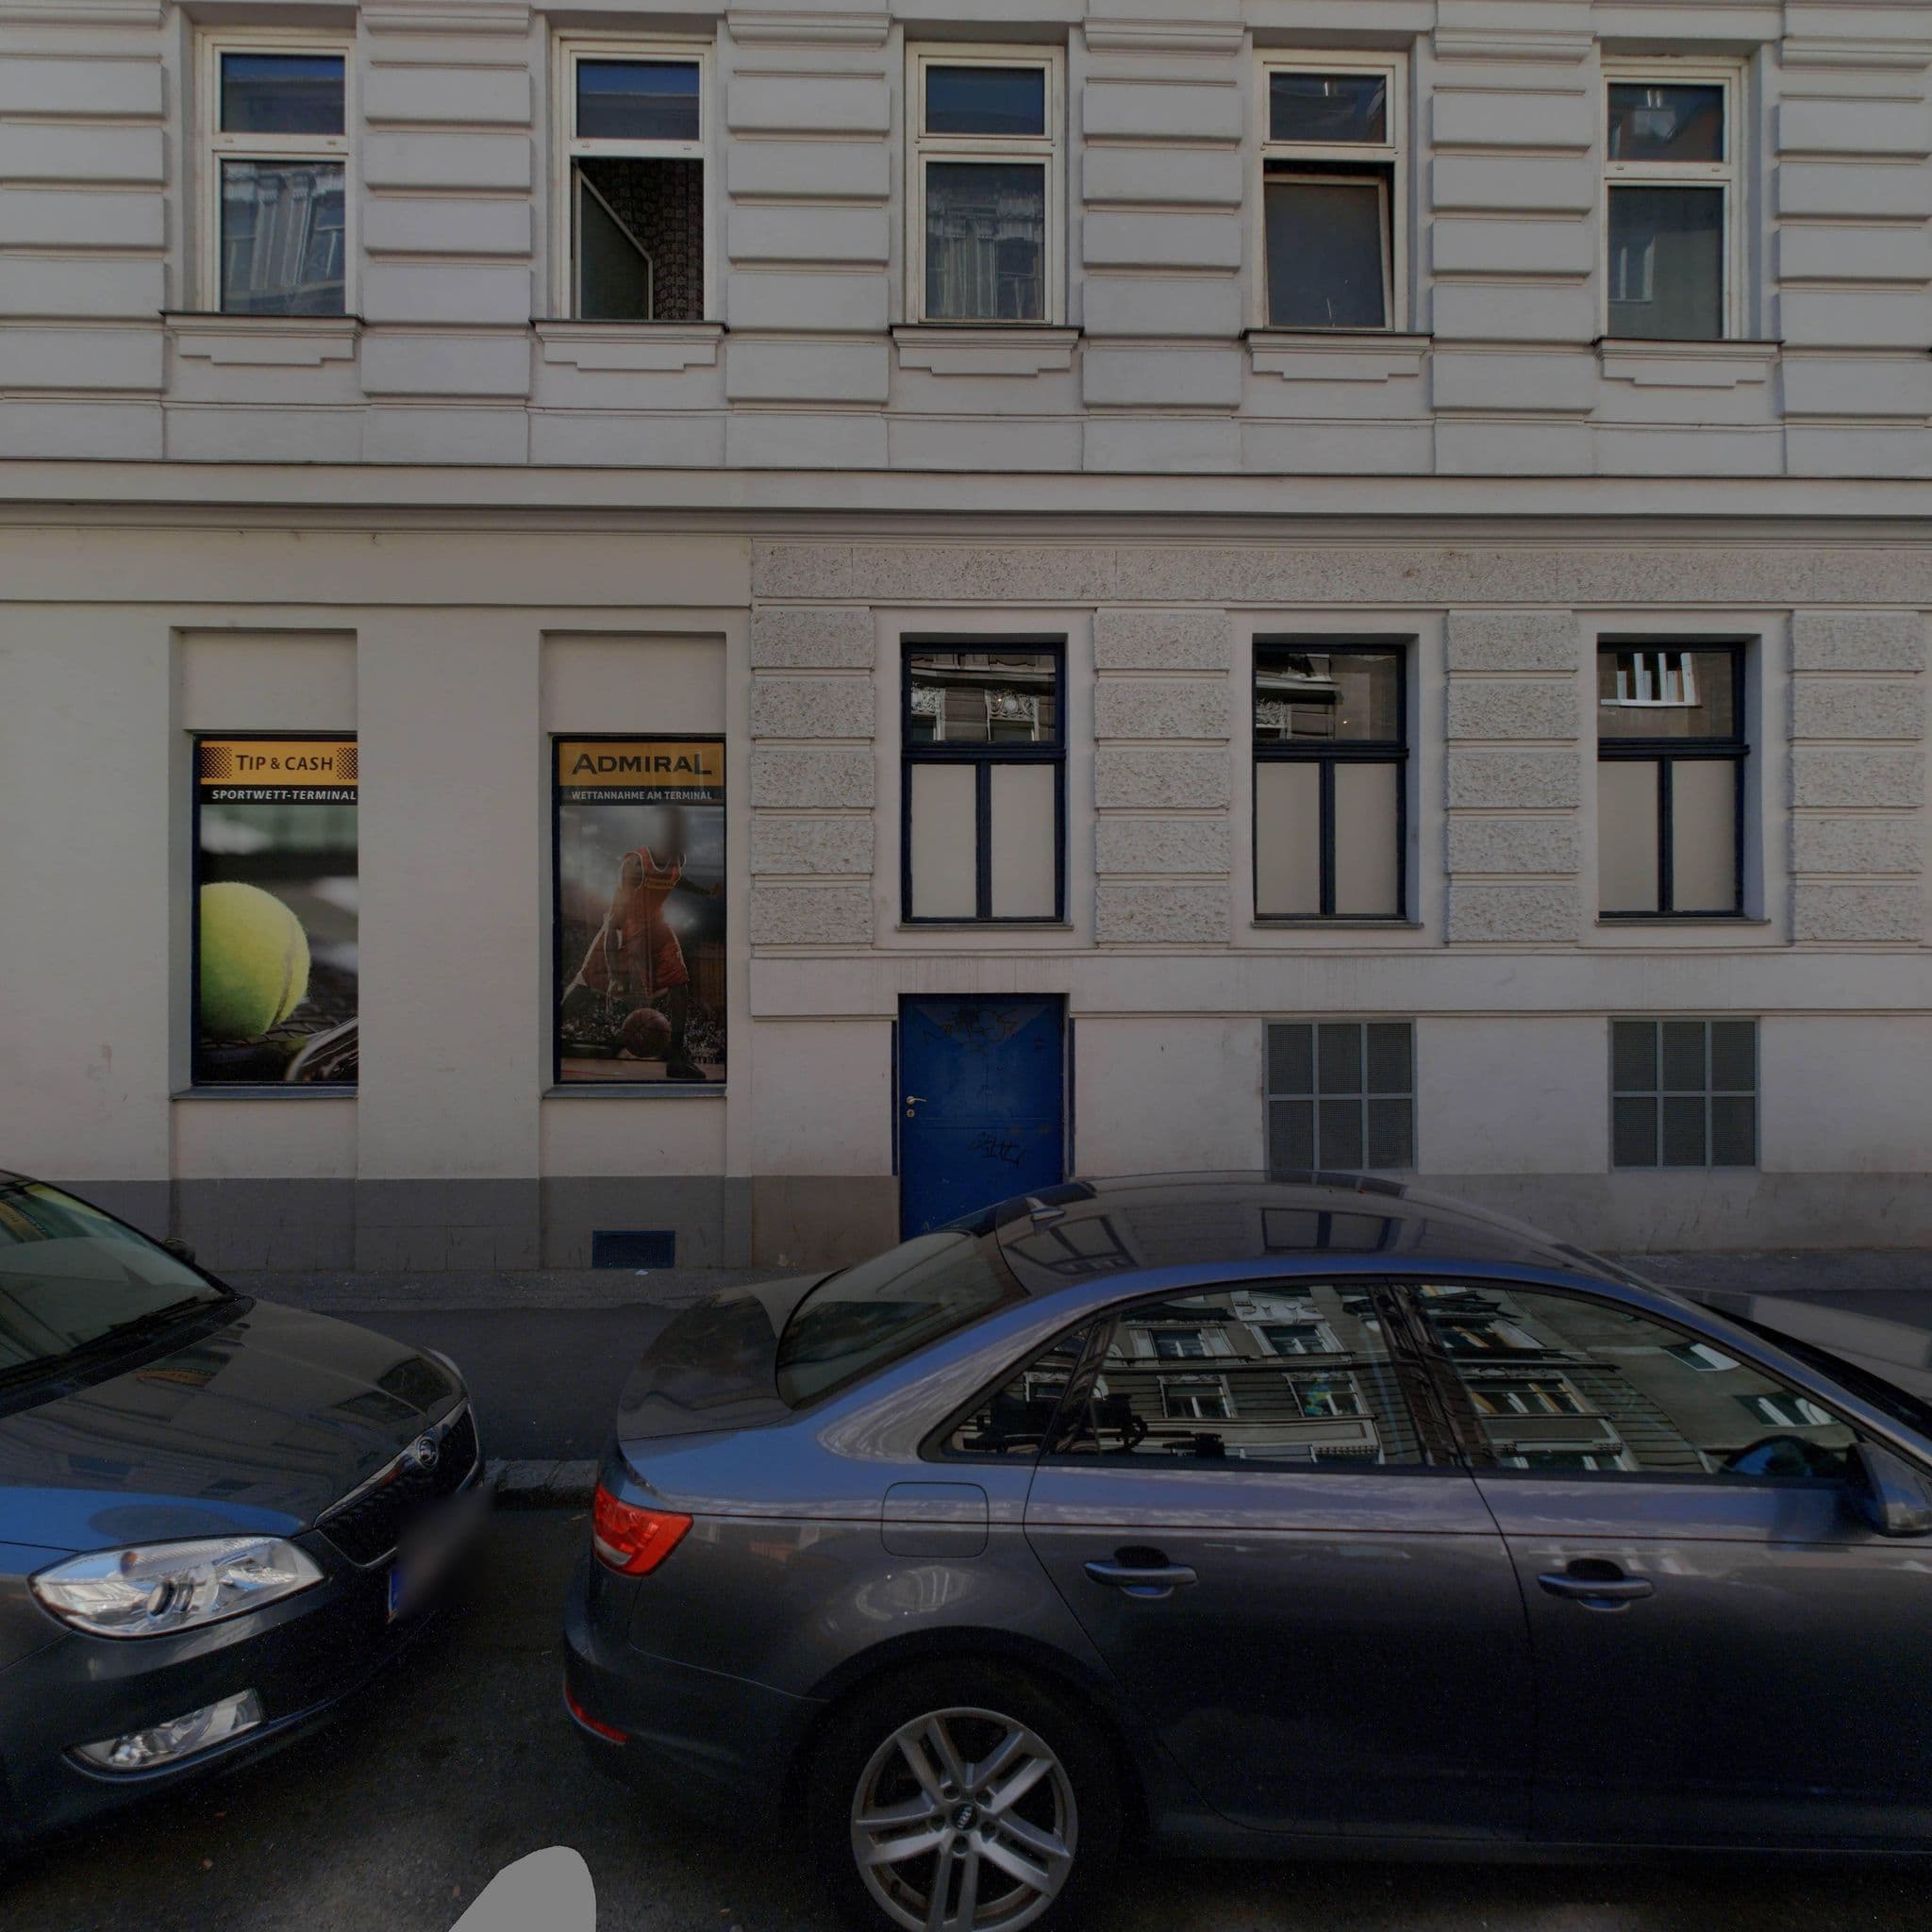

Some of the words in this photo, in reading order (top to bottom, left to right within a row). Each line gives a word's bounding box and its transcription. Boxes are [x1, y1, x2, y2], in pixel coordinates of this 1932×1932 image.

[236, 755, 265, 771] TIP
[271, 758, 281, 770] &
[285, 758, 333, 771] CASH
[572, 754, 712, 774] ADMIRAL
[211, 790, 357, 800] SPORTWETT-TERMINAL
[572, 791, 644, 800] WETTANNAHME
[647, 791, 662, 800] AM
[664, 791, 712, 800] TERMINAL
